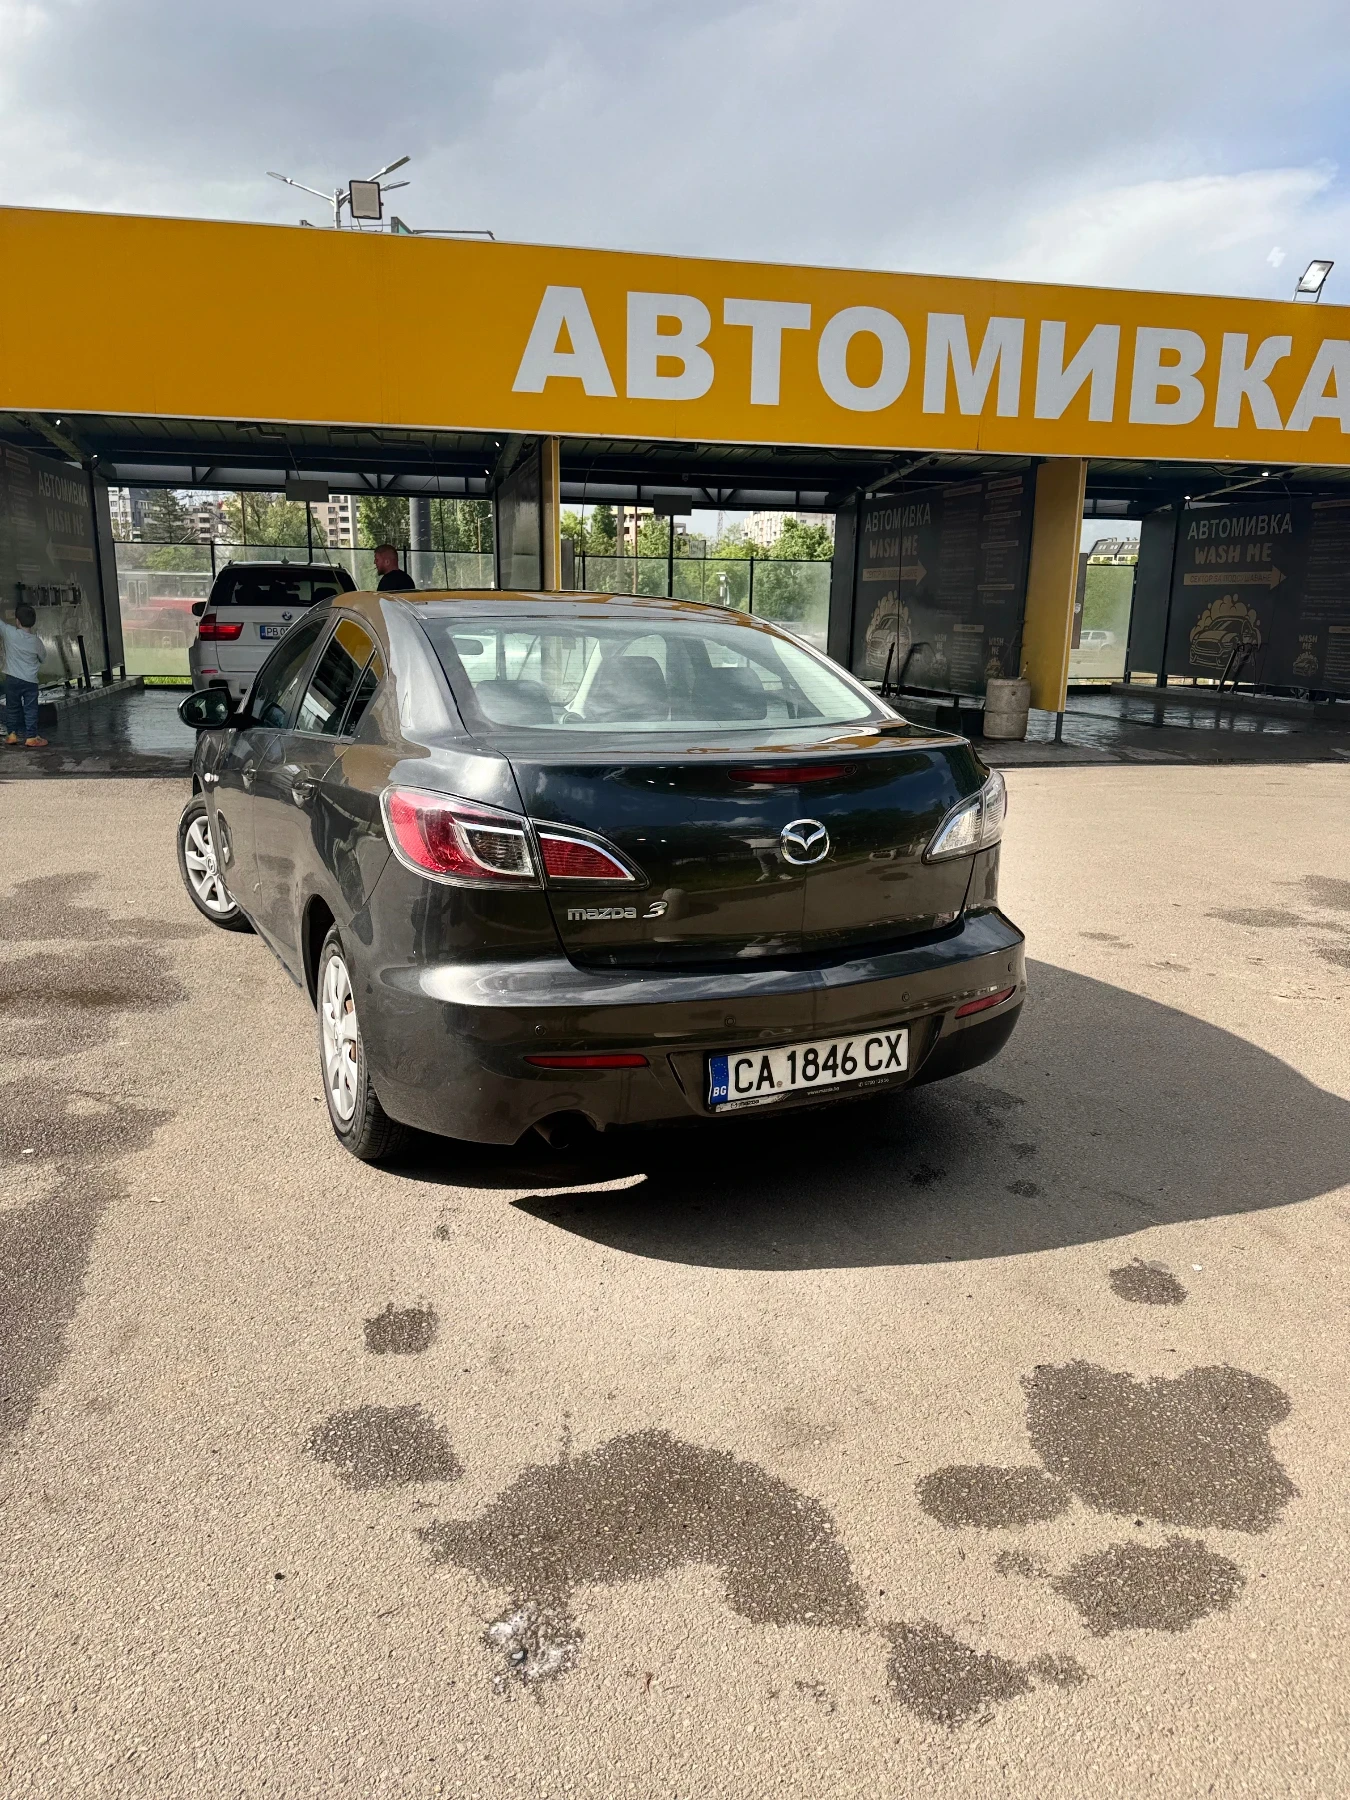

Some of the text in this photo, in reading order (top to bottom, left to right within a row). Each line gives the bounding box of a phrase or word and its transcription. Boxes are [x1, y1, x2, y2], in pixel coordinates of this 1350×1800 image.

[512, 285, 1350, 432] АВТОМИВКА
[38, 470, 89, 508] АВТОМИВКА
[46, 507, 71, 534] WASH
[73, 513, 85, 536] ME
[865, 502, 931, 533] АВТОМИВКА
[1187, 512, 1293, 541] АВТОМИВКА
[869, 534, 918, 559] WASH ME
[1194, 542, 1273, 565] WASH ME
[1189, 575, 1213, 583] СЕКТОР
[1298, 634, 1318, 643] WASH
[567, 901, 668, 921] mazda 3
[734, 1033, 902, 1094] CA 1846 CX
[712, 1085, 727, 1097] BG
